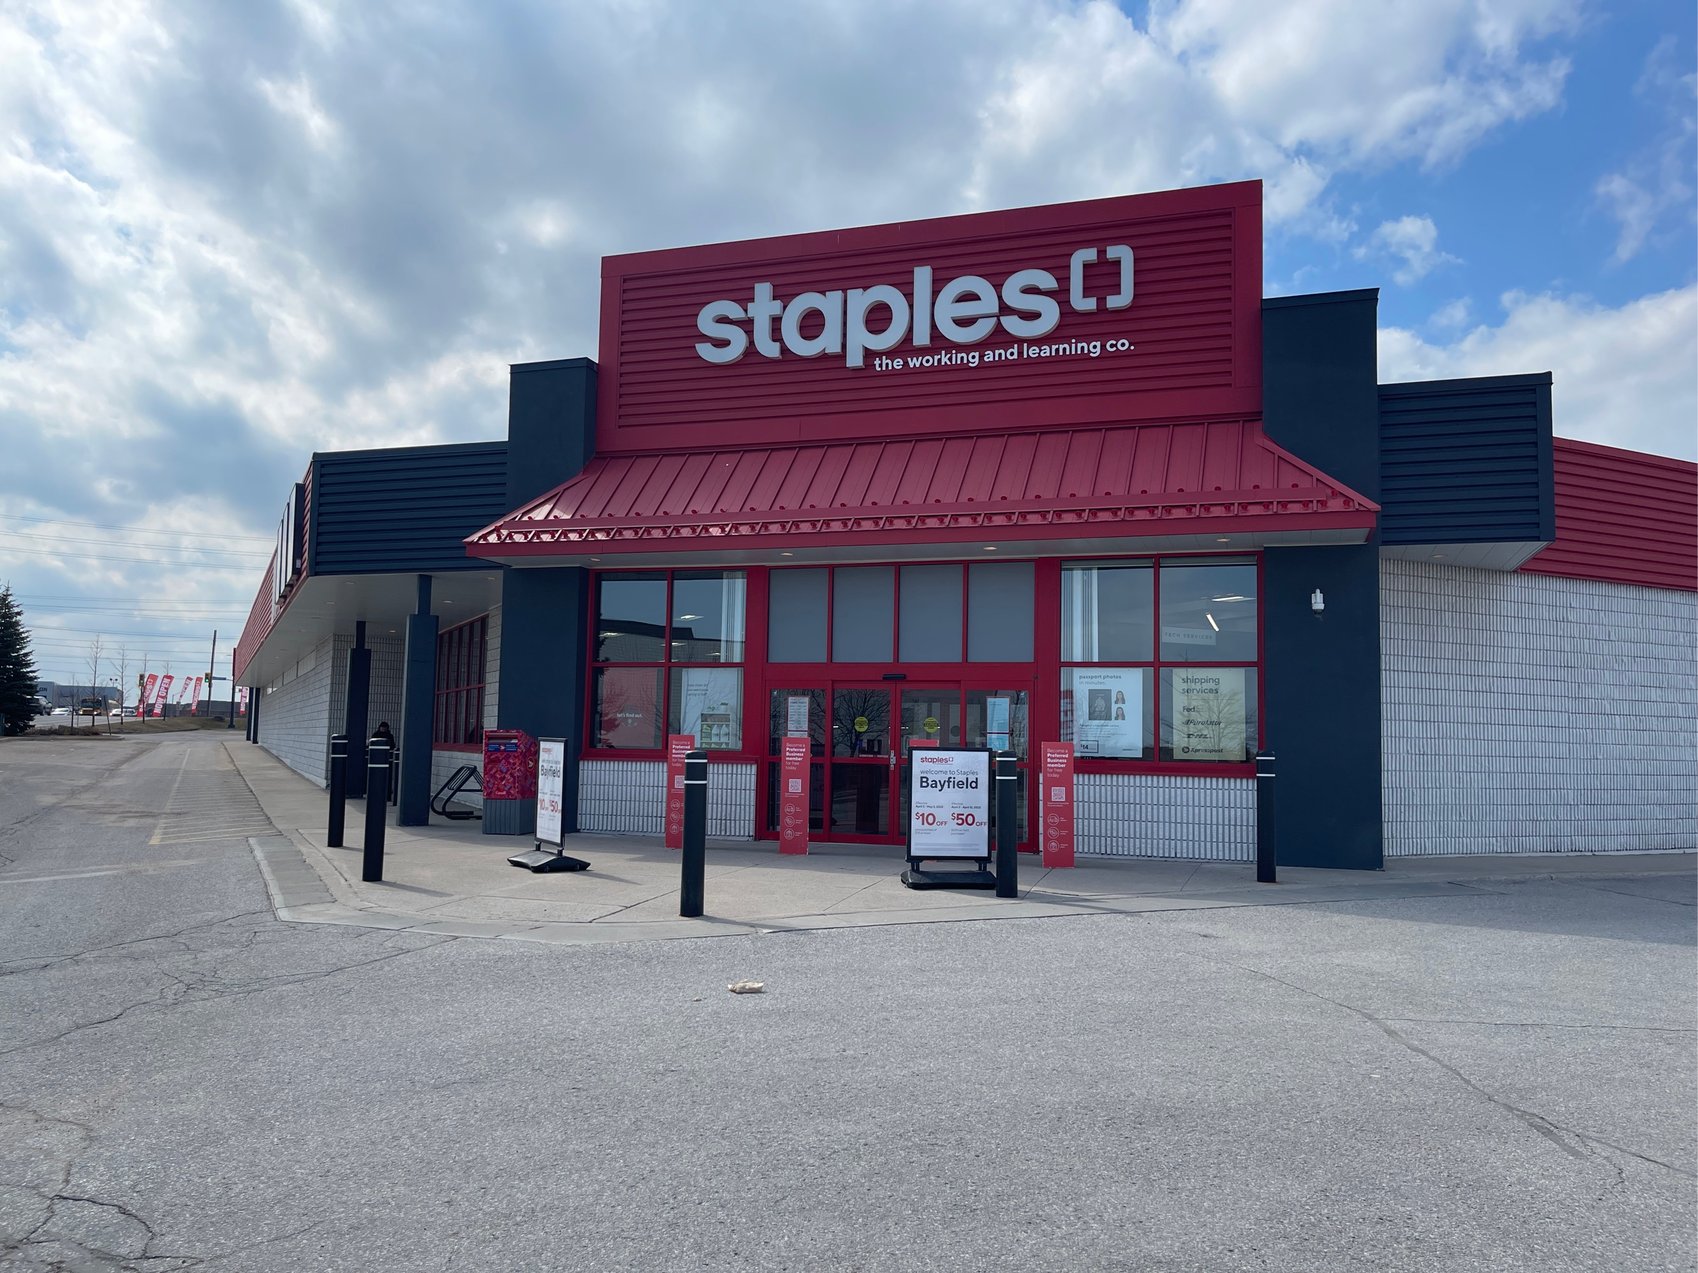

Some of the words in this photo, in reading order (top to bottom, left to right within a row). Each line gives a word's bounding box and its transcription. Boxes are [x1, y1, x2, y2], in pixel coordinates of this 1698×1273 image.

[695, 265, 1061, 369] staples
[874, 356, 904, 371] the
[908, 349, 979, 371] working
[984, 347, 1018, 361] and
[1022, 338, 1101, 359] learning
[1106, 338, 1135, 352] co.
[1182, 676, 1220, 685] shipping
[920, 756, 949, 764] staples
[541, 764, 560, 778] Bayfield
[957, 769, 978, 777] Staples
[920, 776, 978, 791] Bayfield
[915, 812, 936, 826] $10
[951, 812, 975, 826] $50
